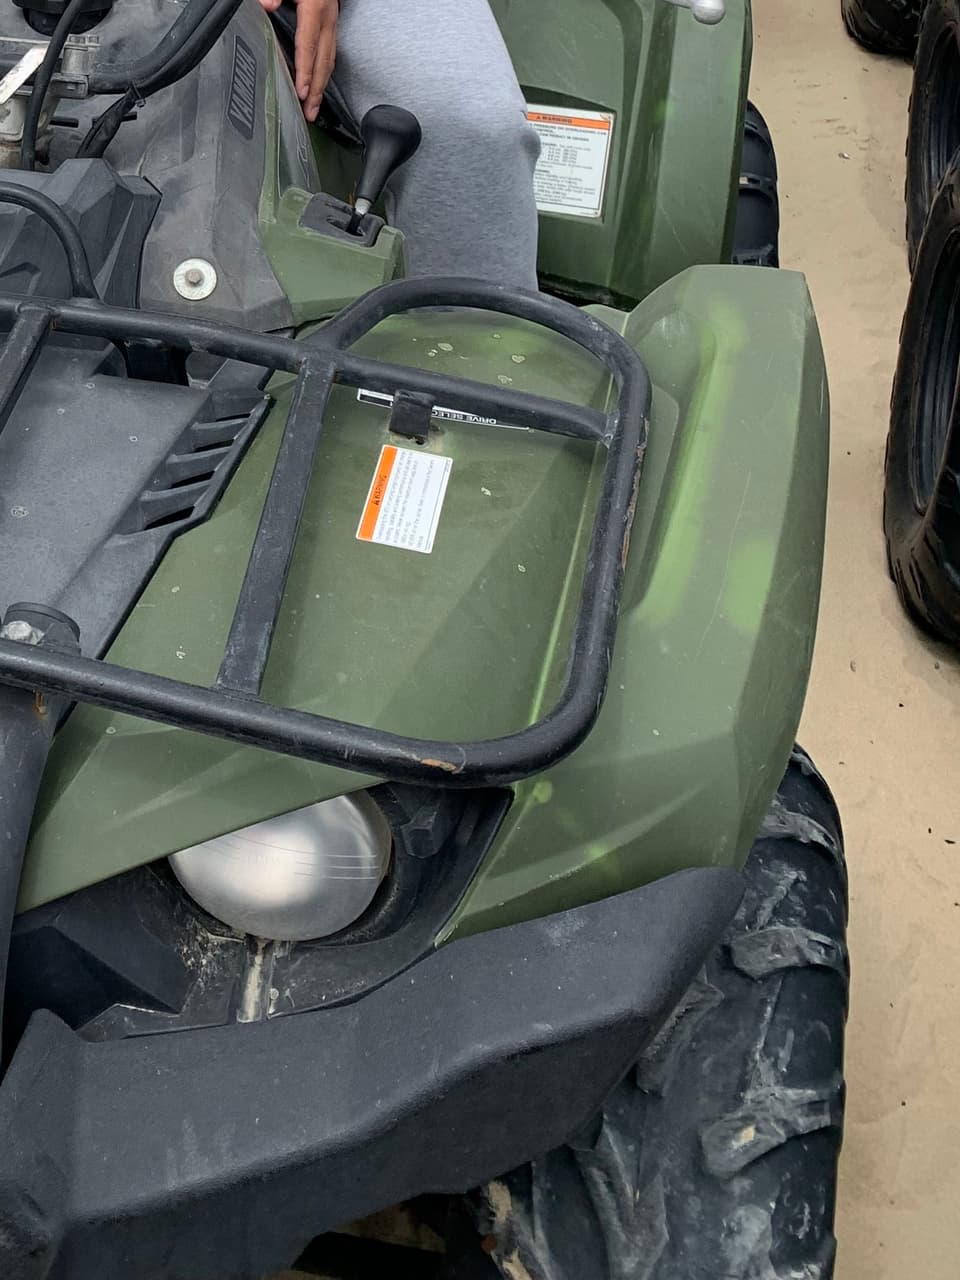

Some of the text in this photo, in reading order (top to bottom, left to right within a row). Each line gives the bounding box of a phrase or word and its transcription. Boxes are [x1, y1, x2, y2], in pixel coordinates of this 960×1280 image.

[230, 43, 255, 130] YAMAHA
[432, 410, 497, 425] DRIVE SELEC
